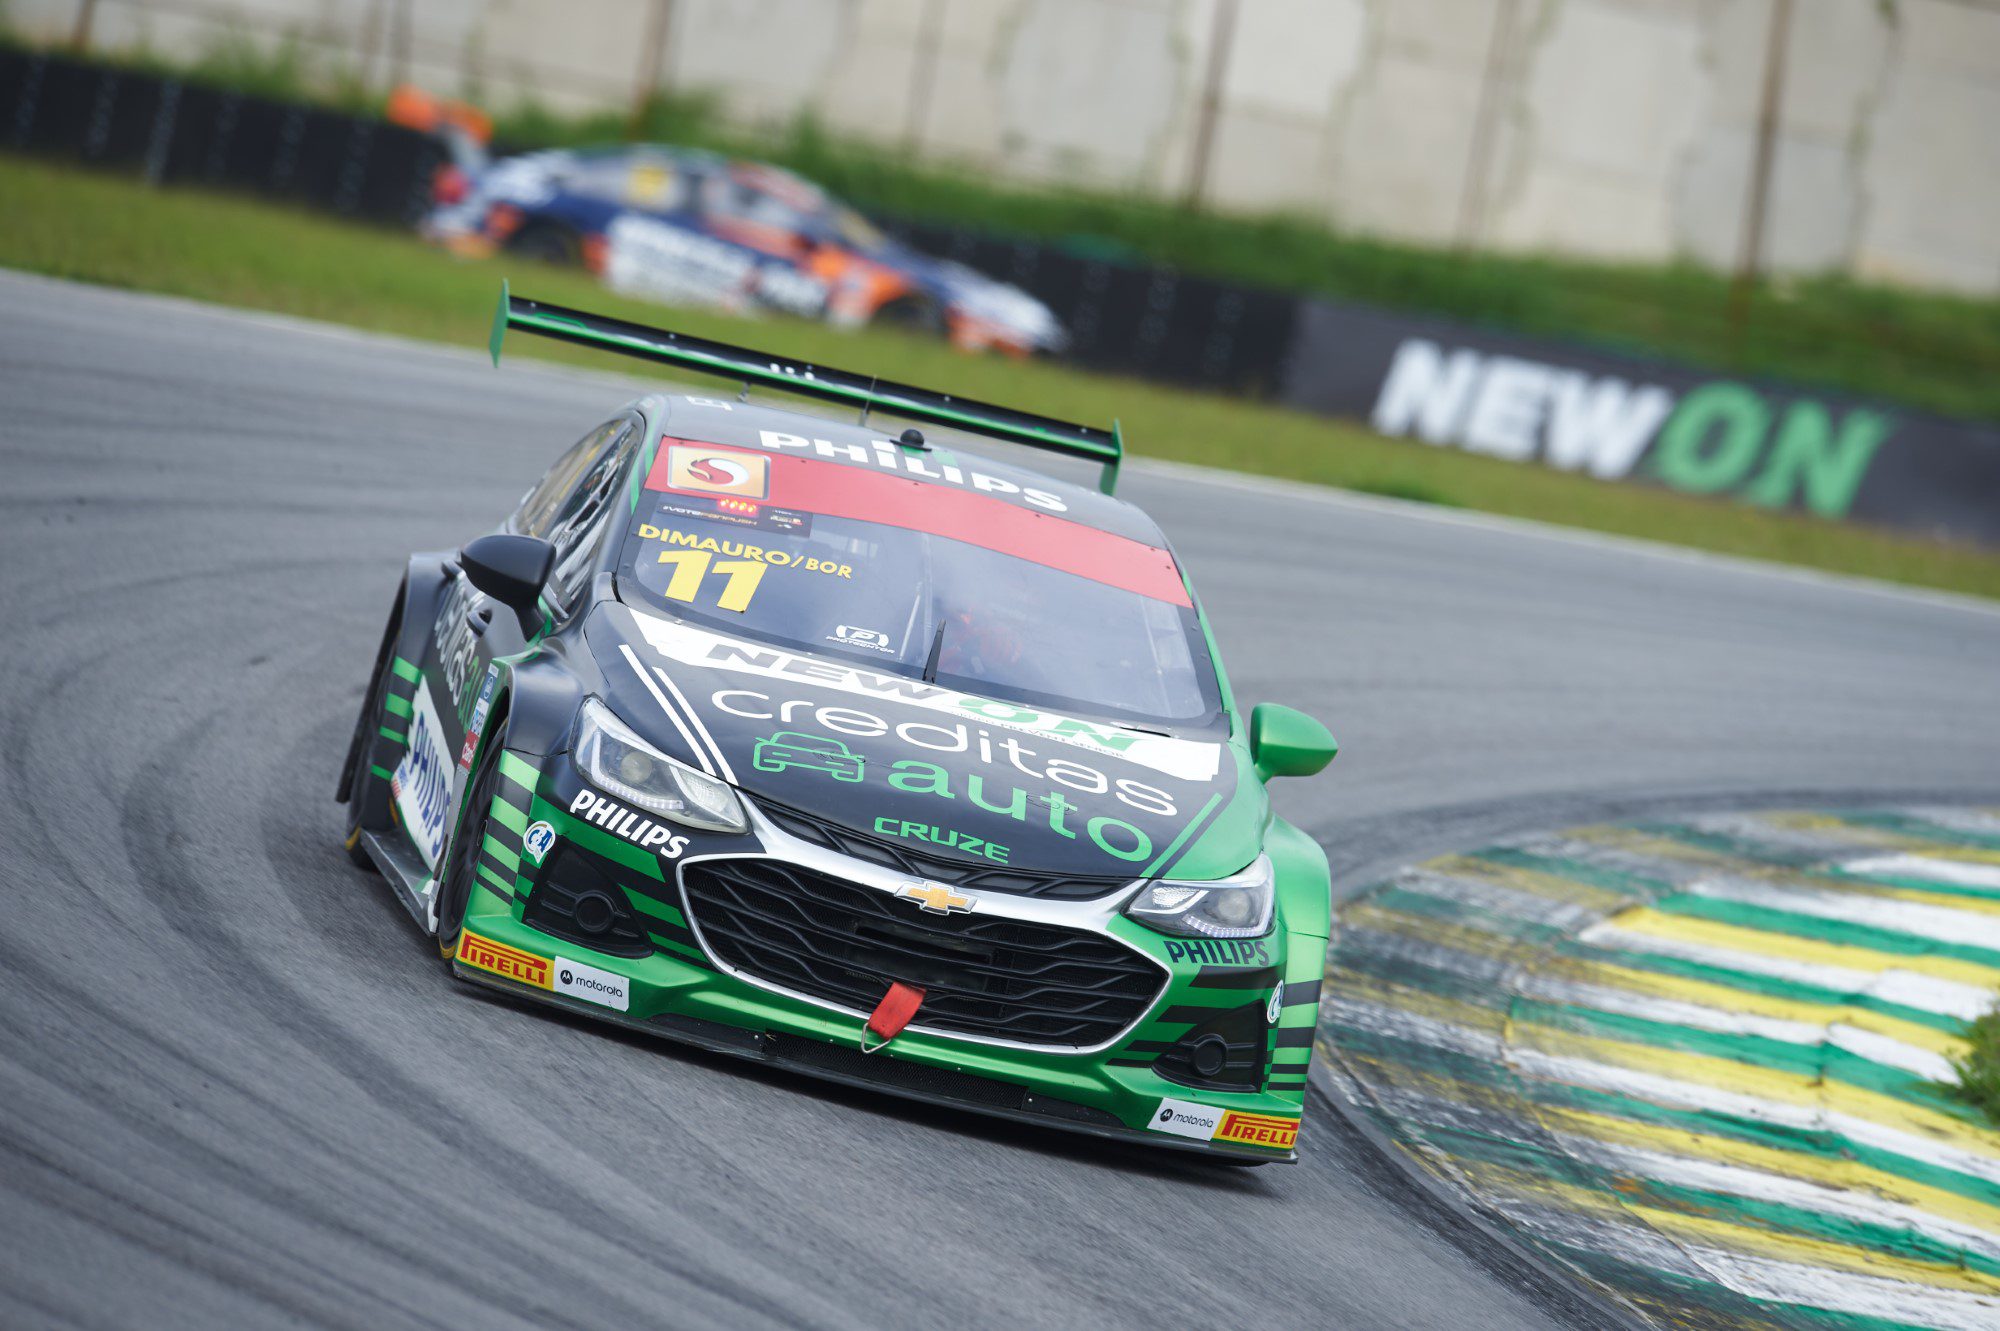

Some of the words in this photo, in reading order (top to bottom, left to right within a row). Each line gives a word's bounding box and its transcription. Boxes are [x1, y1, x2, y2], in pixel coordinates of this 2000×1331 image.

[1372, 338, 1890, 519] NEWON
[759, 430, 1067, 512] PHILIPS
[657, 549, 768, 613] 11
[711, 690, 1177, 816] creditas
[569, 789, 690, 859] PHILIPS
[874, 816, 1010, 863] CRUZE
[888, 760, 1153, 862] auto
[461, 933, 548, 985] PIRELLI
[1163, 940, 1269, 966] PHILIPS
[575, 975, 623, 998] motorola
[1173, 1113, 1214, 1129] motorola
[1221, 1113, 1299, 1146] PIRELLI
